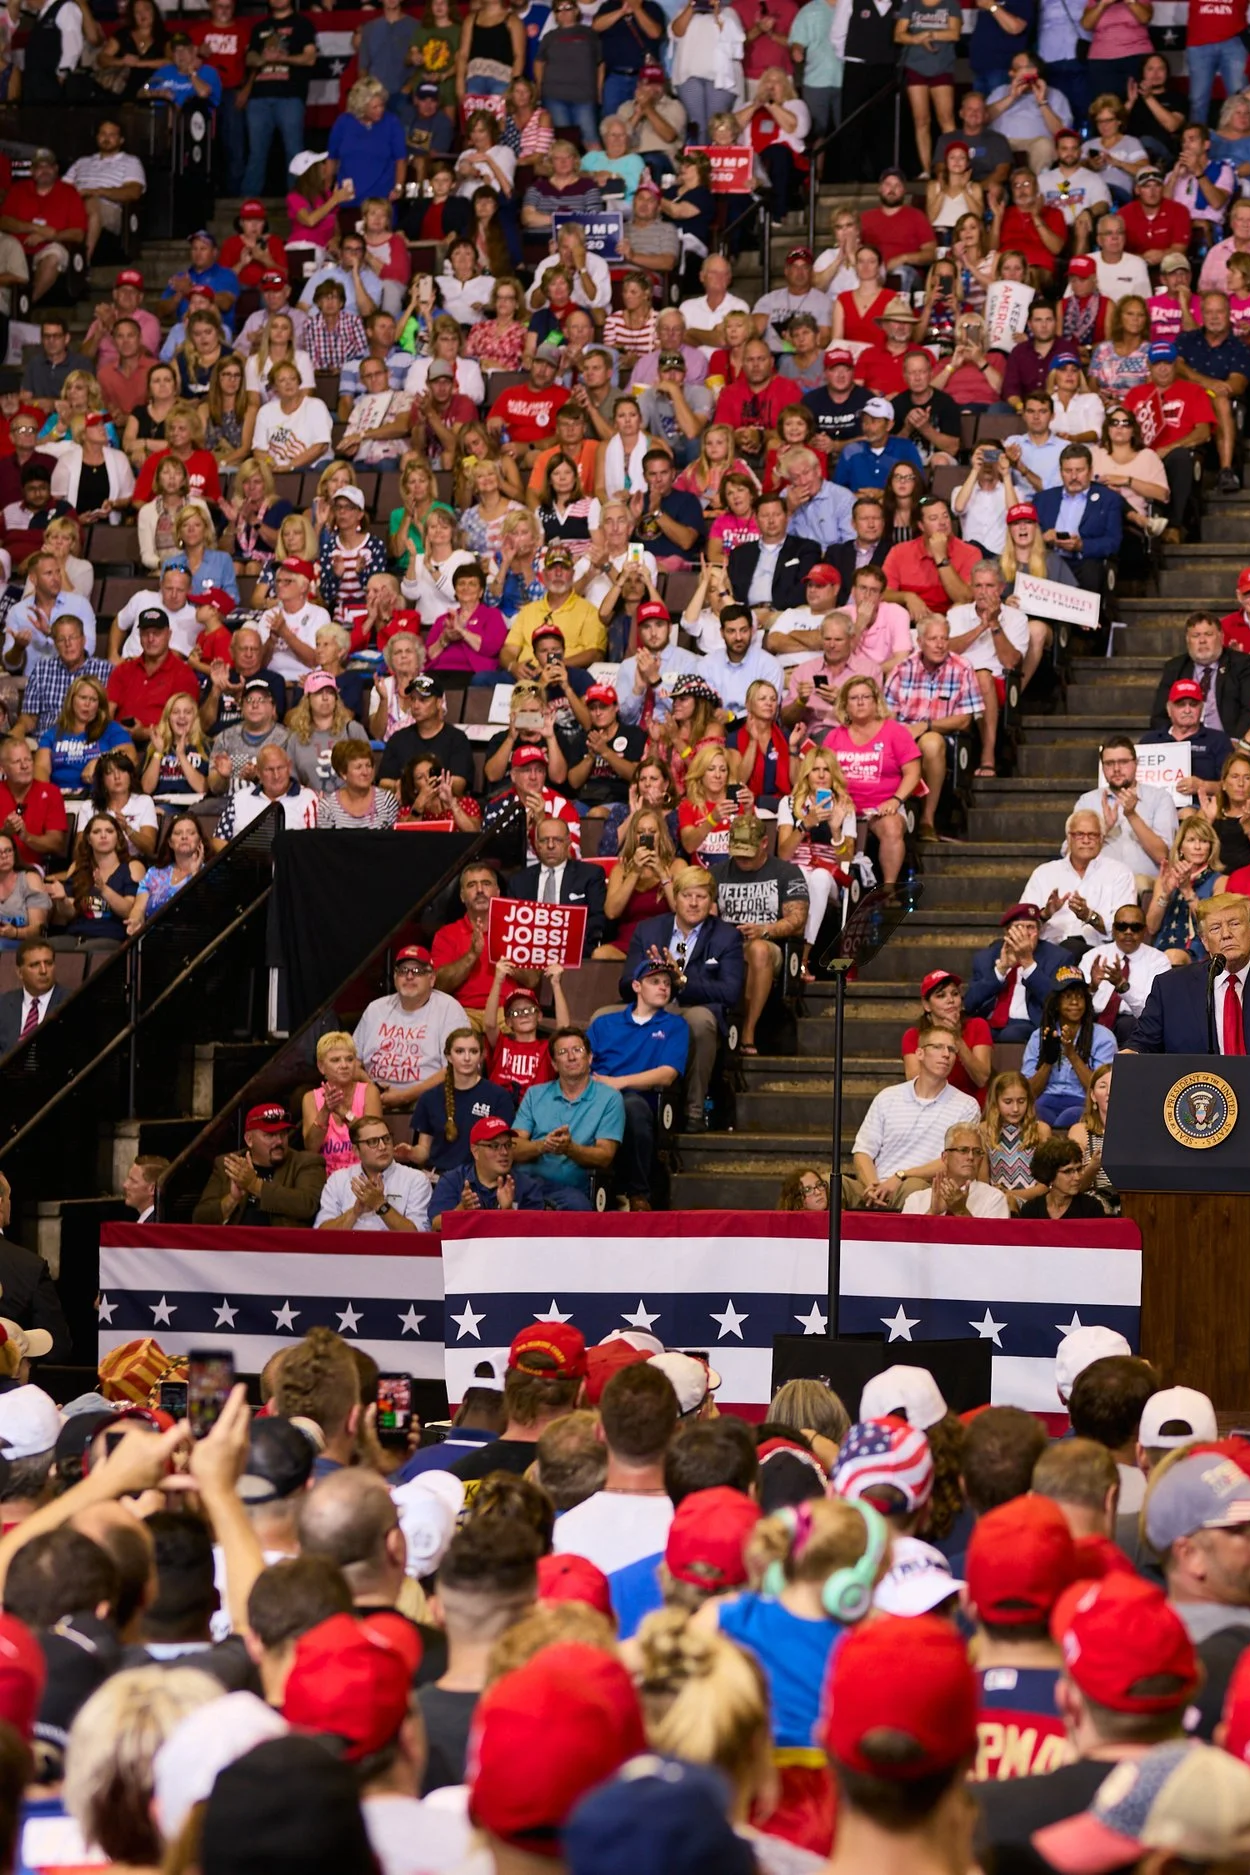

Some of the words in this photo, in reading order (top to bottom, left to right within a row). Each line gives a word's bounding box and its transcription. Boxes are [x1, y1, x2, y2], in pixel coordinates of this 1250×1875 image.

[993, 284, 1014, 343] AMERICA
[1022, 580, 1093, 610] Women
[1052, 600, 1085, 612] TRUMP
[1135, 769, 1185, 783] ERICA
[719, 879, 779, 900] VETERANS
[504, 905, 571, 928] JOBS!
[725, 896, 770, 916] BEFORE
[502, 924, 569, 947] JOBS!
[501, 944, 566, 965] JOBS!
[378, 1022, 429, 1040] MAKE
[369, 1052, 424, 1069] GREAT
[369, 1066, 421, 1083] AGAIN
[1167, 1075, 1201, 1109] PRESIDENT
[1219, 1083, 1237, 1117] UNITED
[1175, 1129, 1195, 1145] SEAL
[1206, 1121, 1232, 1144] STATES
